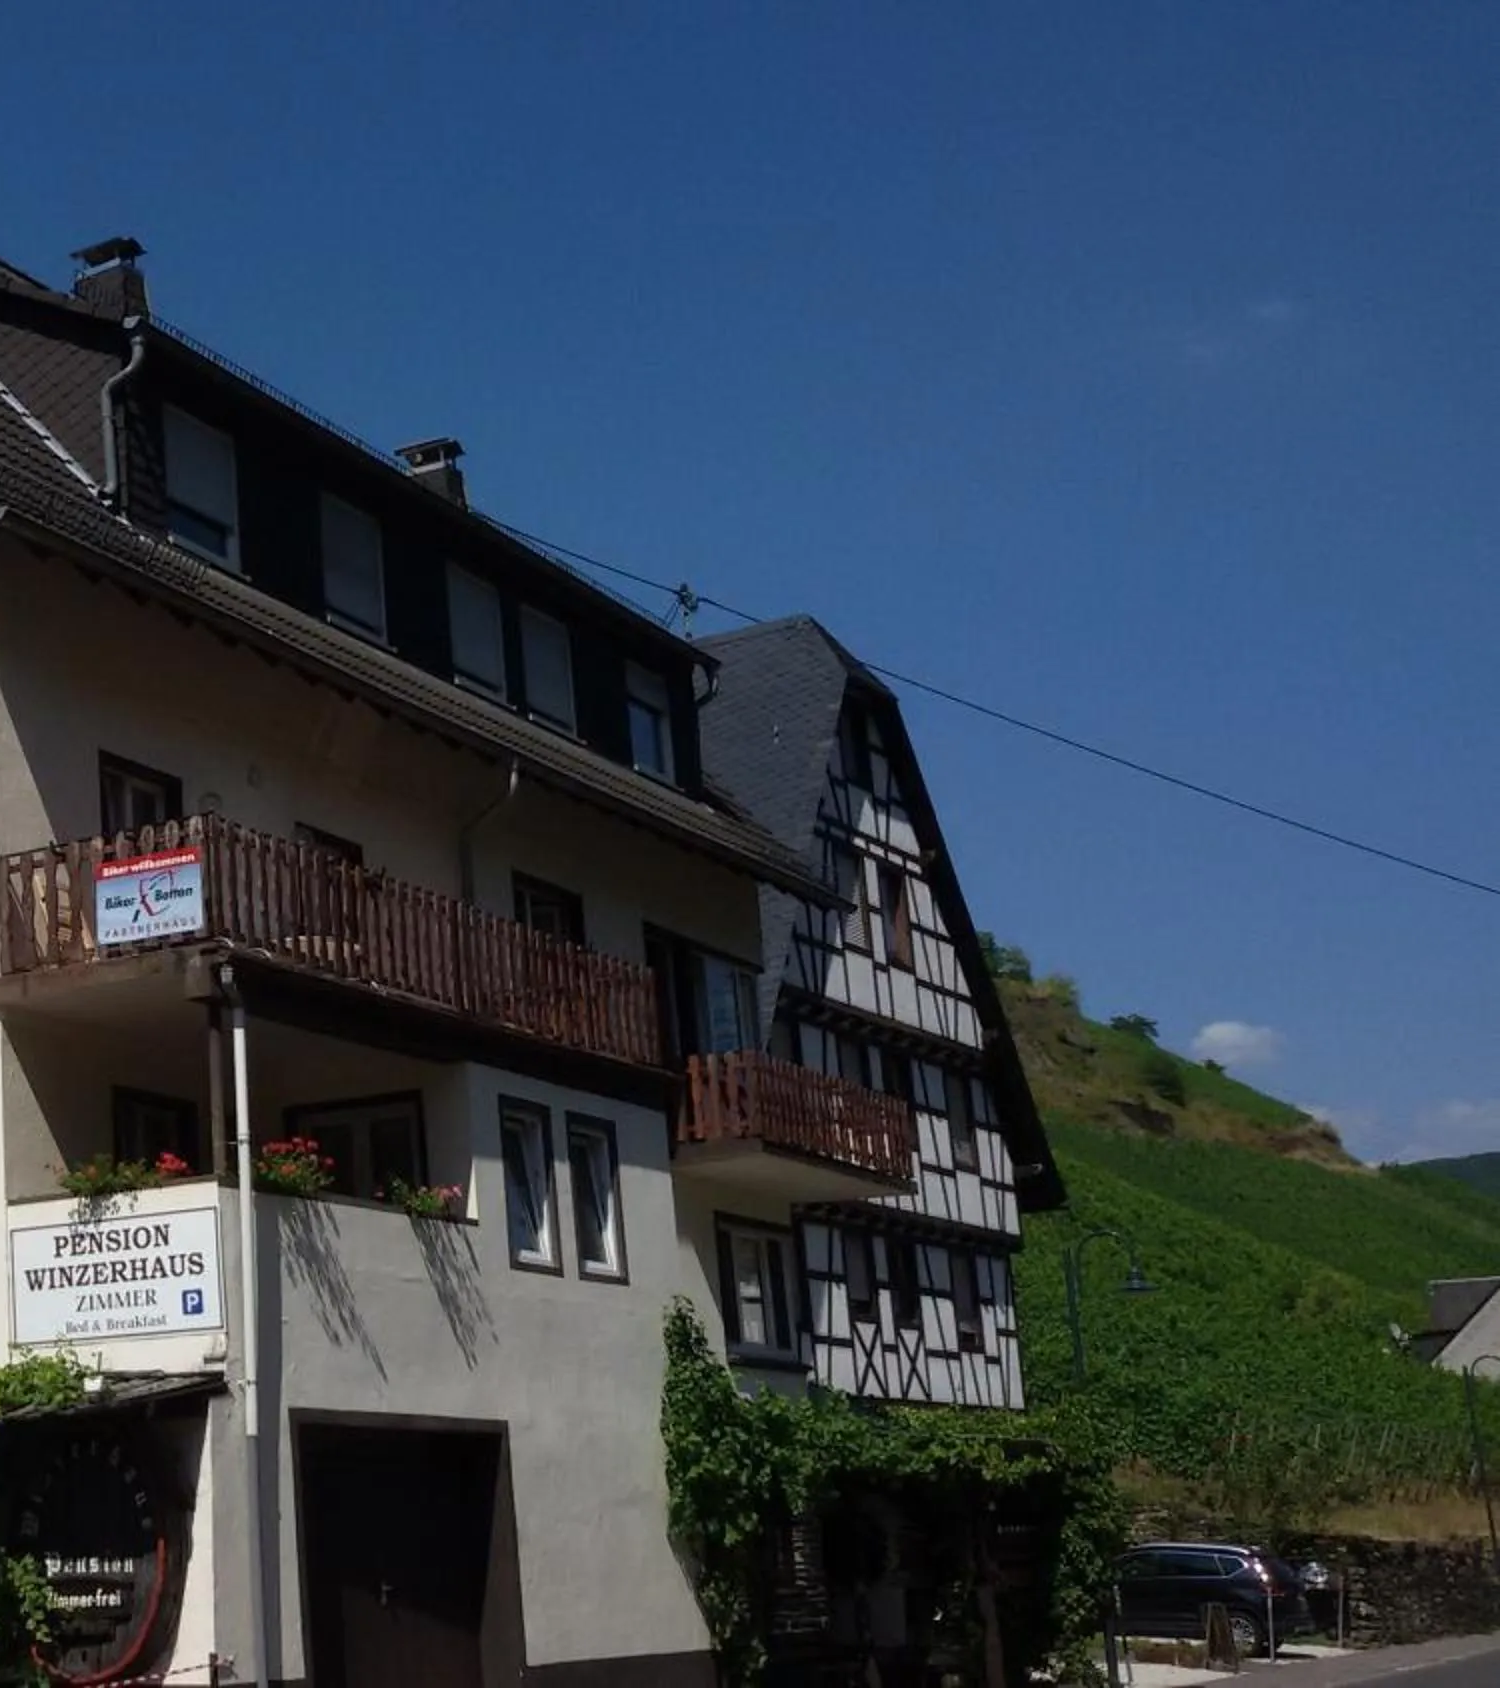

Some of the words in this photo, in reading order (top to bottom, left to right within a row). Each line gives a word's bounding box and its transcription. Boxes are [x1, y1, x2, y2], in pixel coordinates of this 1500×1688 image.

[103, 865, 129, 876] Biker
[131, 853, 196, 873] willkommen
[105, 896, 136, 910] Biker
[52, 1223, 171, 1259] PENSION
[25, 1252, 205, 1292] WINZERHAUS
[76, 1288, 158, 1313] ZIMMER
[186, 1293, 199, 1313] P
[66, 1320, 89, 1334] Bed
[91, 1319, 102, 1332] &
[106, 1314, 168, 1331] Breakfast
[44, 1552, 134, 1578] Pension
